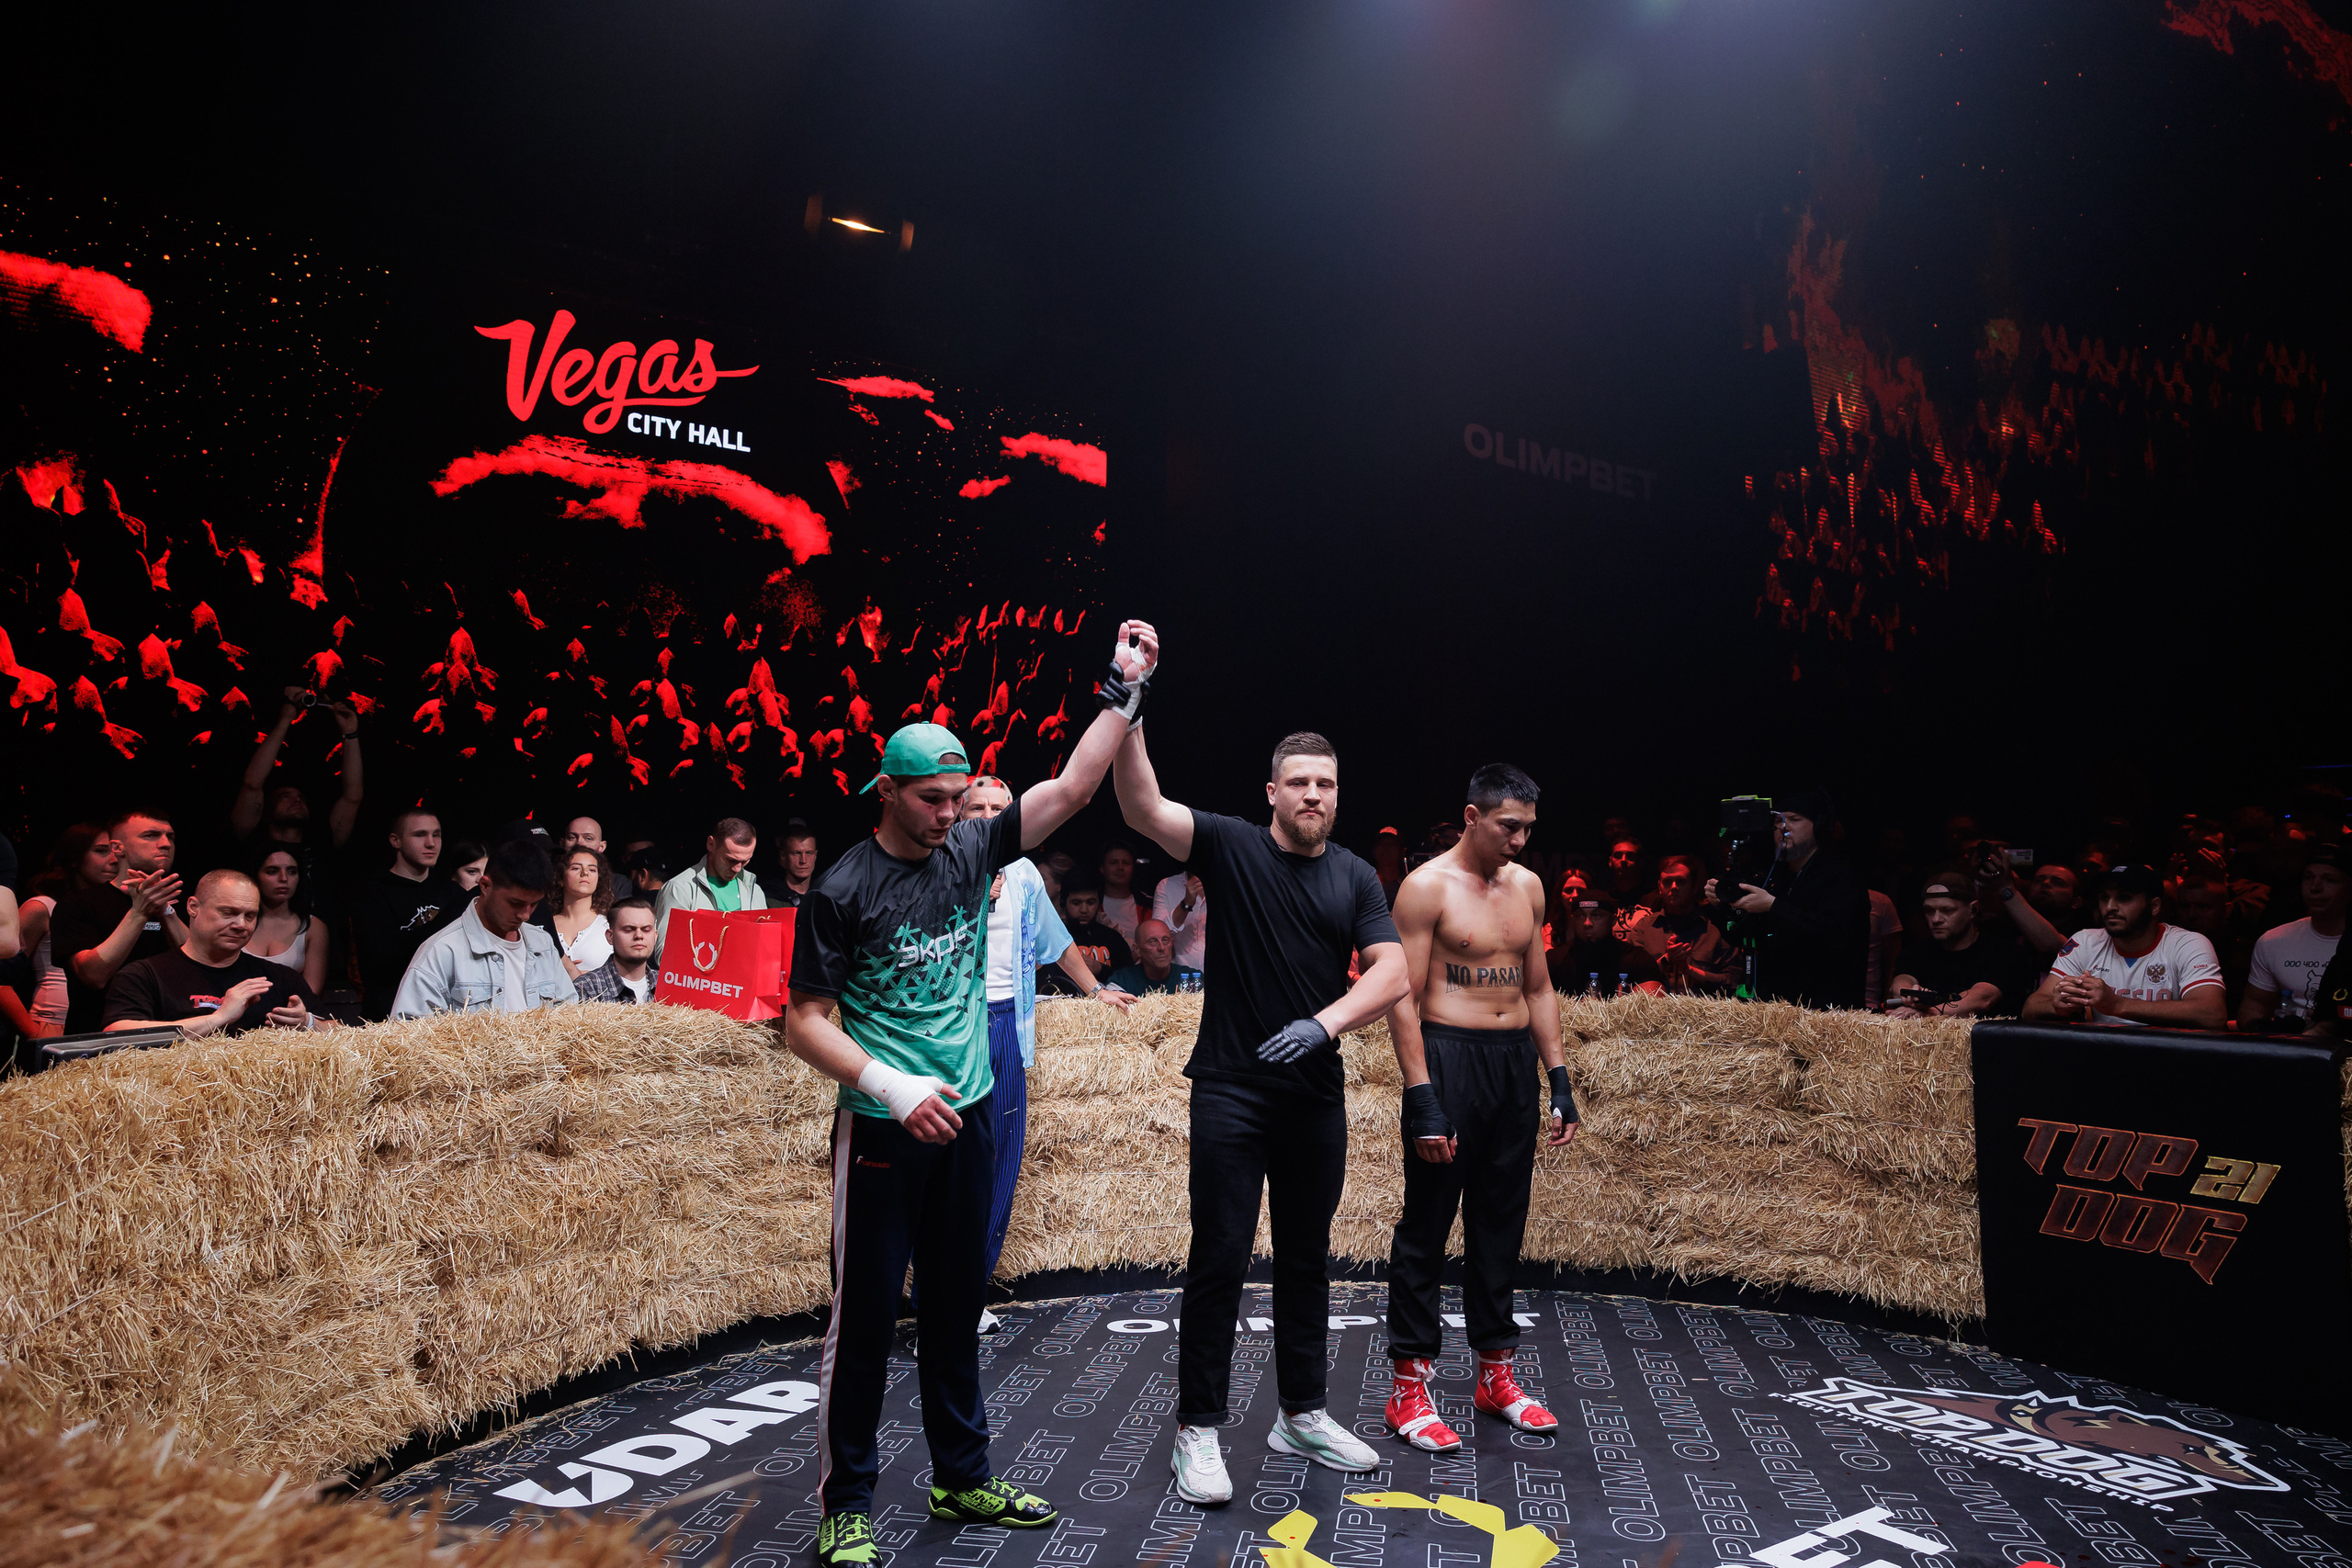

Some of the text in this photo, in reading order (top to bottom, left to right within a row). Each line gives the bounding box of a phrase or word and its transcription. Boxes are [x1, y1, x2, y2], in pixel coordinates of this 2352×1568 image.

[475, 310, 761, 434] Vegas
[627, 412, 752, 453] CITY HALL
[1464, 423, 1658, 501] OLIMPBET
[663, 971, 744, 998] OLIMPBET
[1445, 961, 1472, 994] NO
[2017, 1117, 2282, 1205] TOP 21
[2038, 1183, 2248, 1286] DOG
[1555, 1300, 1615, 1391] OLIMPBET
[1676, 1306, 1758, 1400] OLIMPBET
[1079, 1371, 1180, 1503] OLIMPBET
[1632, 1347, 1720, 1462] OLIMPBET
[1579, 1397, 1667, 1542] OLIMPBET
[1767, 1392, 2176, 1512] FIGHTING CHAMPIONSHIP
